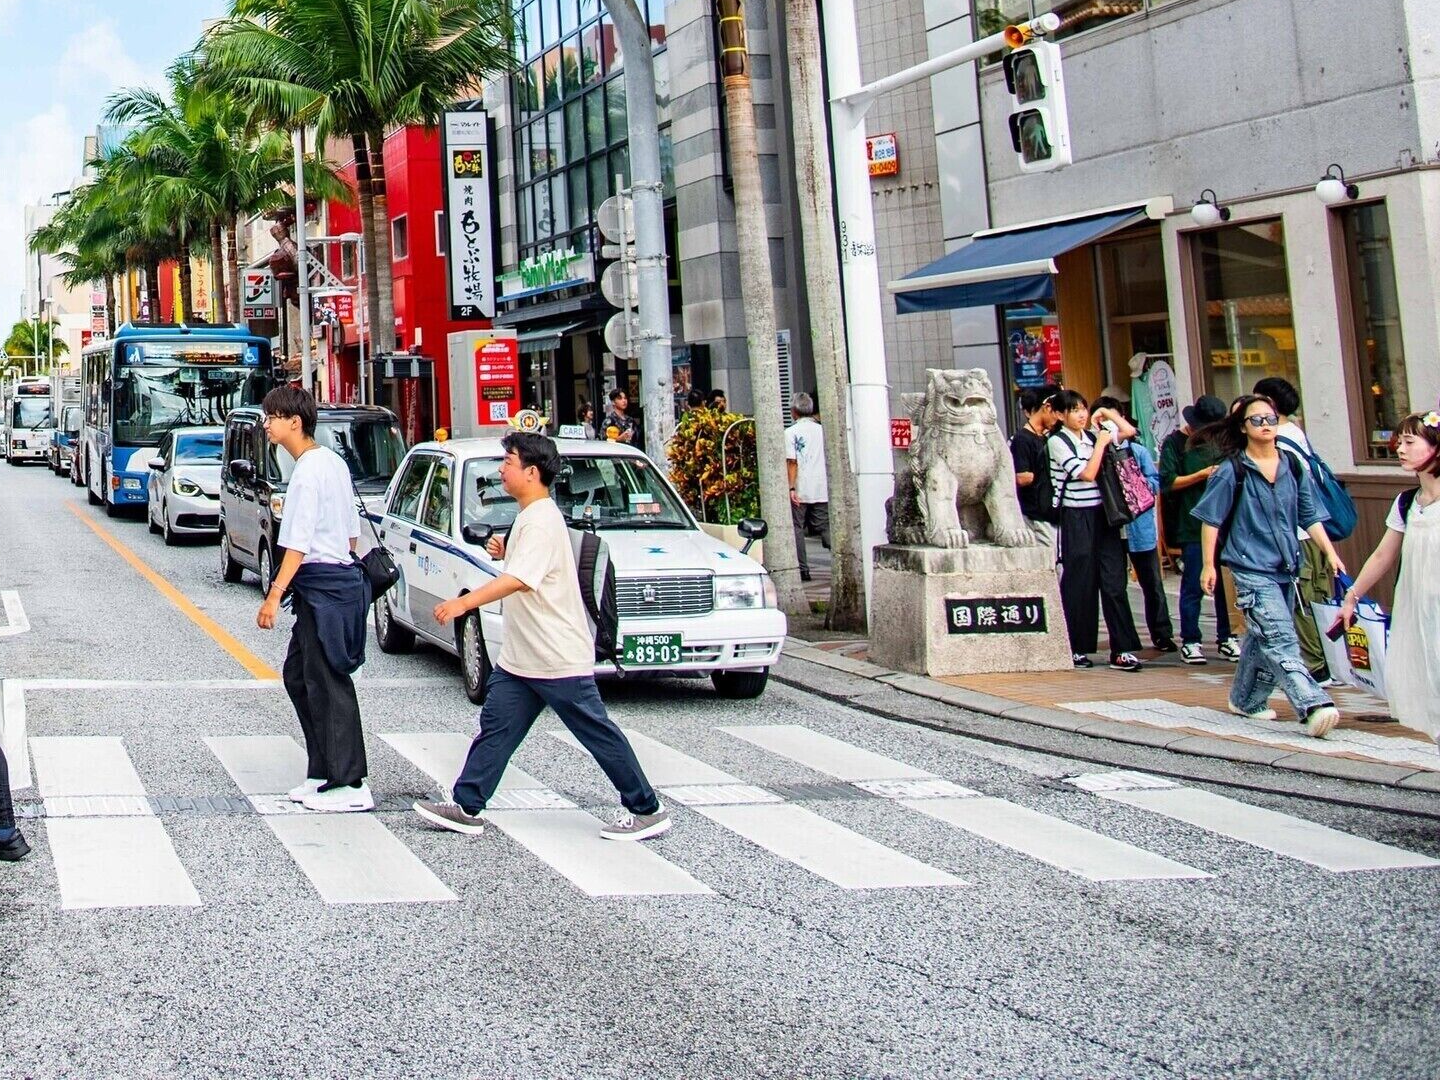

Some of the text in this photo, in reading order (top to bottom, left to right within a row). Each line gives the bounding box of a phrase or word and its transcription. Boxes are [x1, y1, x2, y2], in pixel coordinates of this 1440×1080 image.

[461, 306, 473, 317] 2F
[1157, 398, 1174, 409] OPEN
[563, 426, 584, 435] CARD
[952, 604, 1039, 627] 国際通り
[635, 645, 680, 663] 89-03
